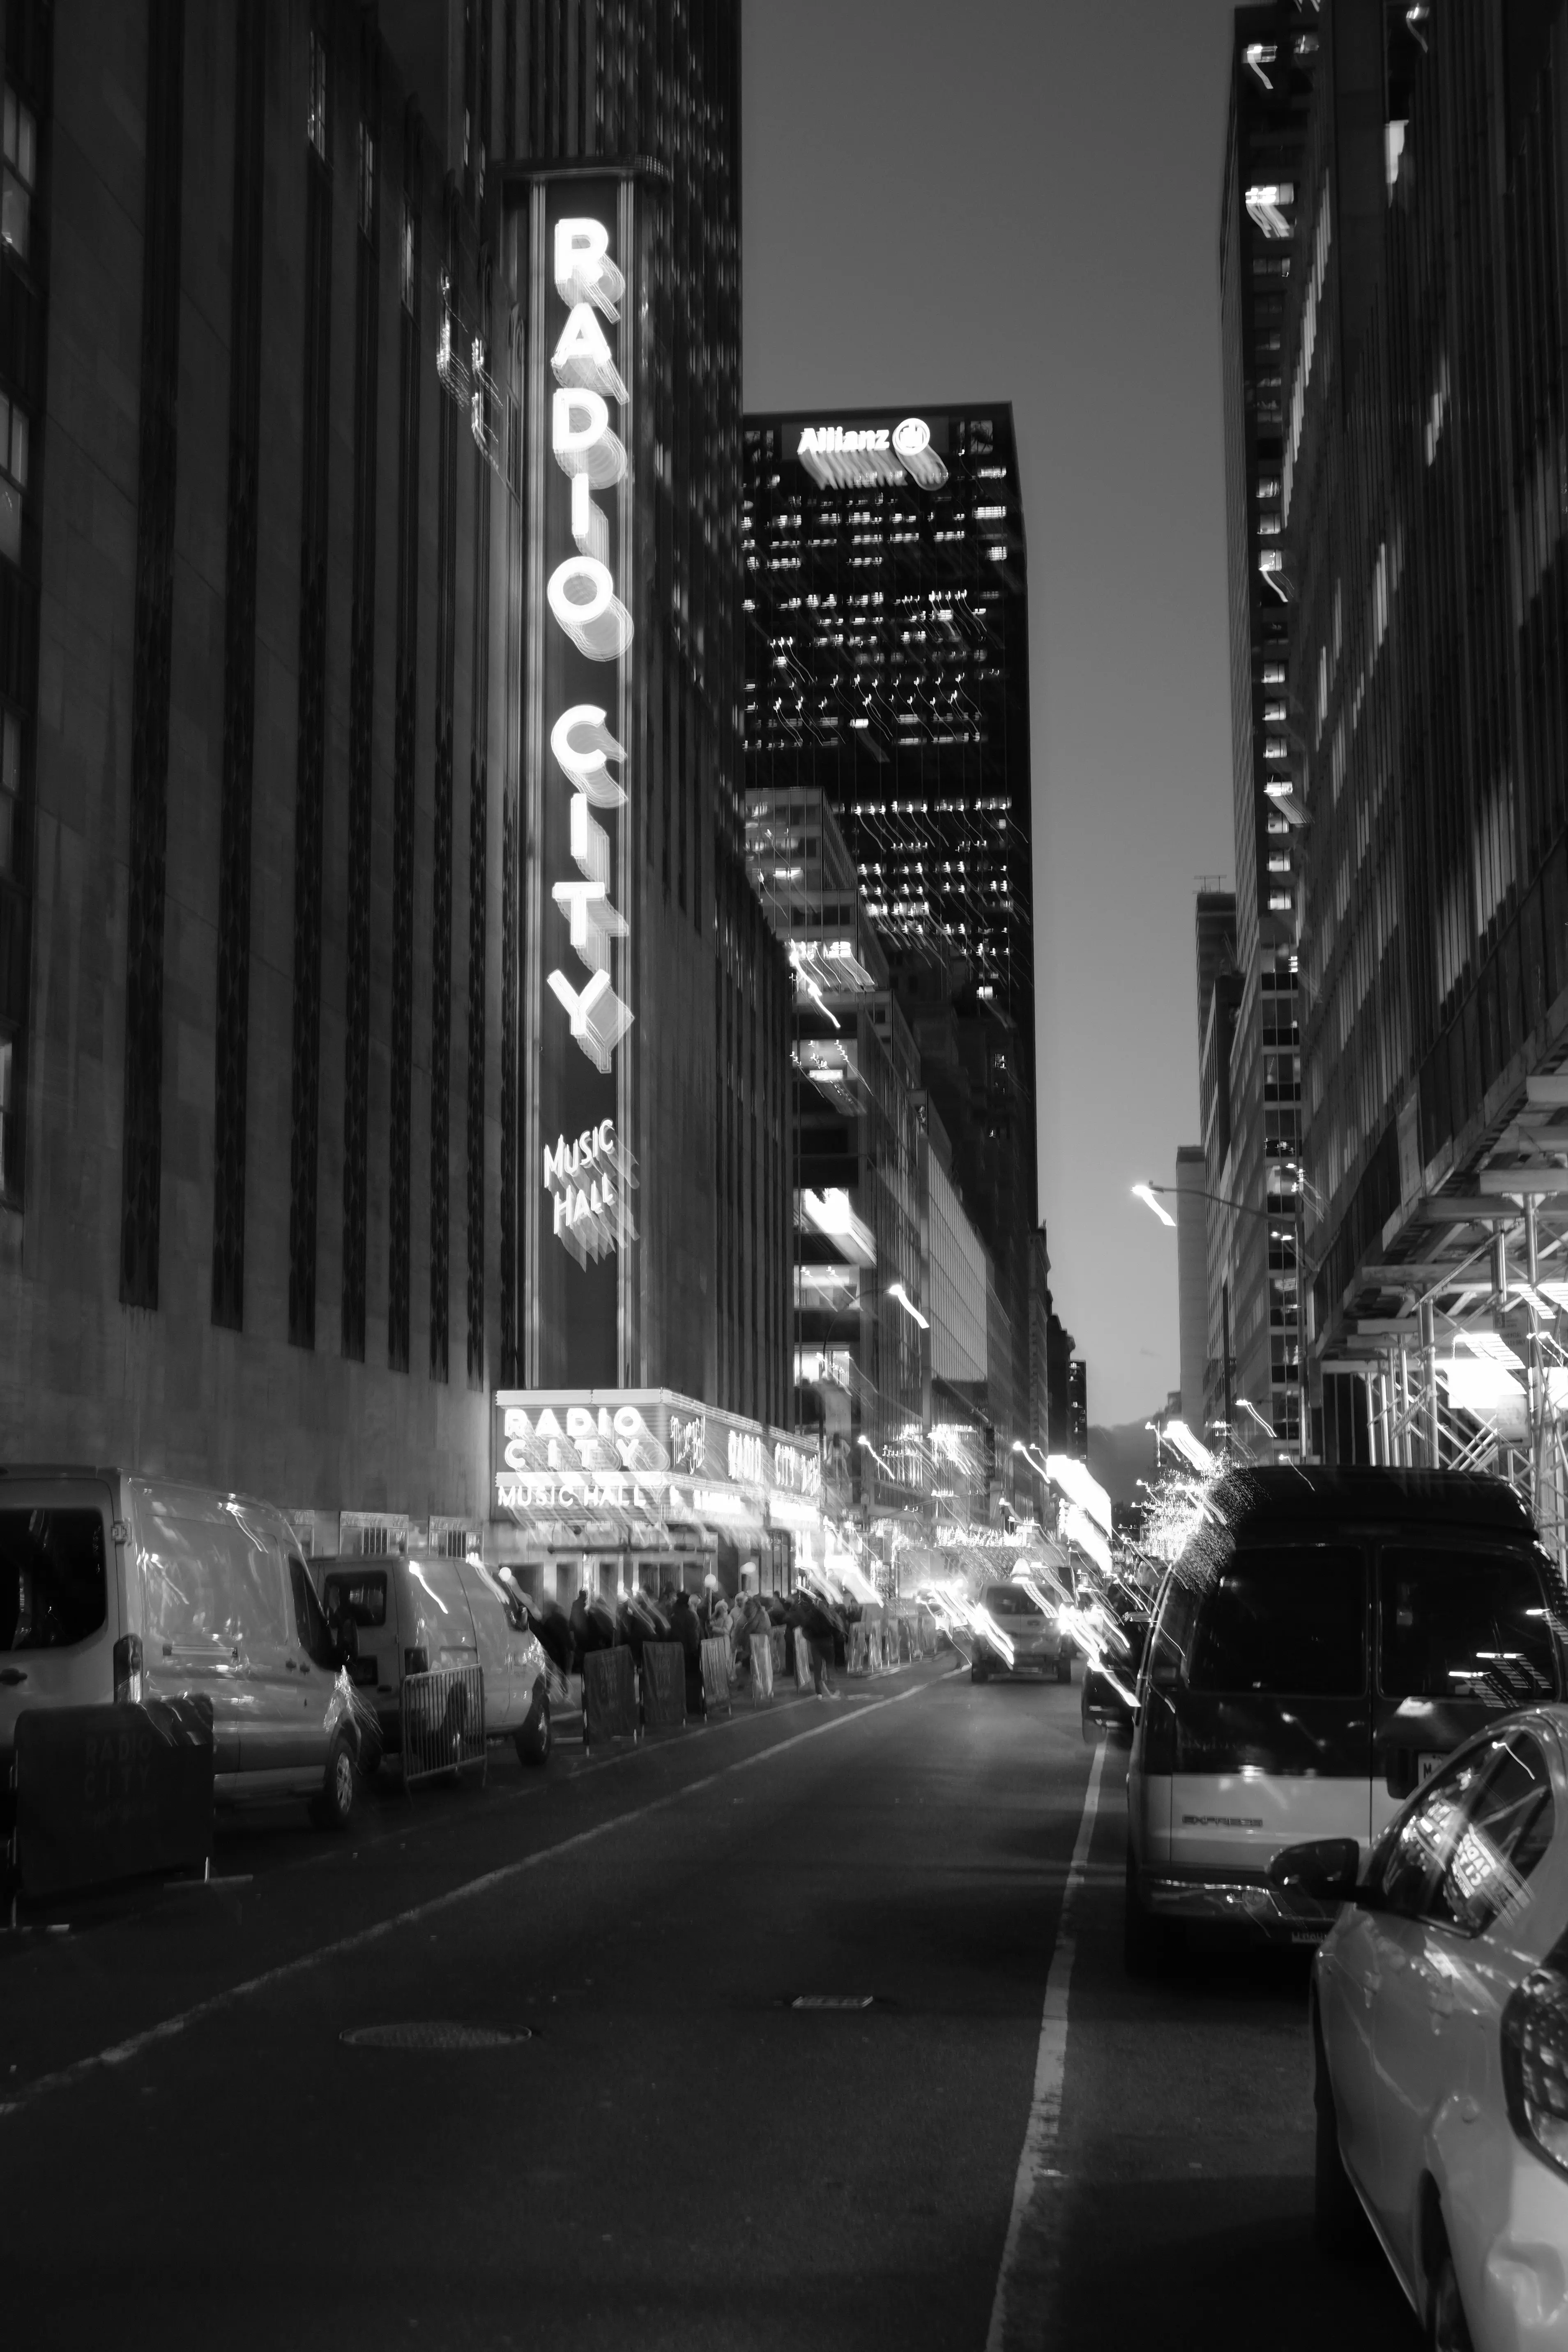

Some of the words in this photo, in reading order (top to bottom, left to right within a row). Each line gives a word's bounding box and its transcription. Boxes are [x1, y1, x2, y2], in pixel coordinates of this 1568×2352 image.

[548, 218, 613, 623] RADIO
[797, 426, 889, 455] Allianz
[547, 705, 610, 1037] CITY
[544, 1118, 615, 1188] MUSIC
[554, 1173, 615, 1235] HALL
[504, 1406, 641, 1436] RADIO
[504, 1438, 639, 1469] CITY
[498, 1485, 574, 1507] MUSIC
[583, 1485, 647, 1507] HALL
[85, 1733, 152, 1766] RADIO
[84, 1763, 150, 1801] CITY
